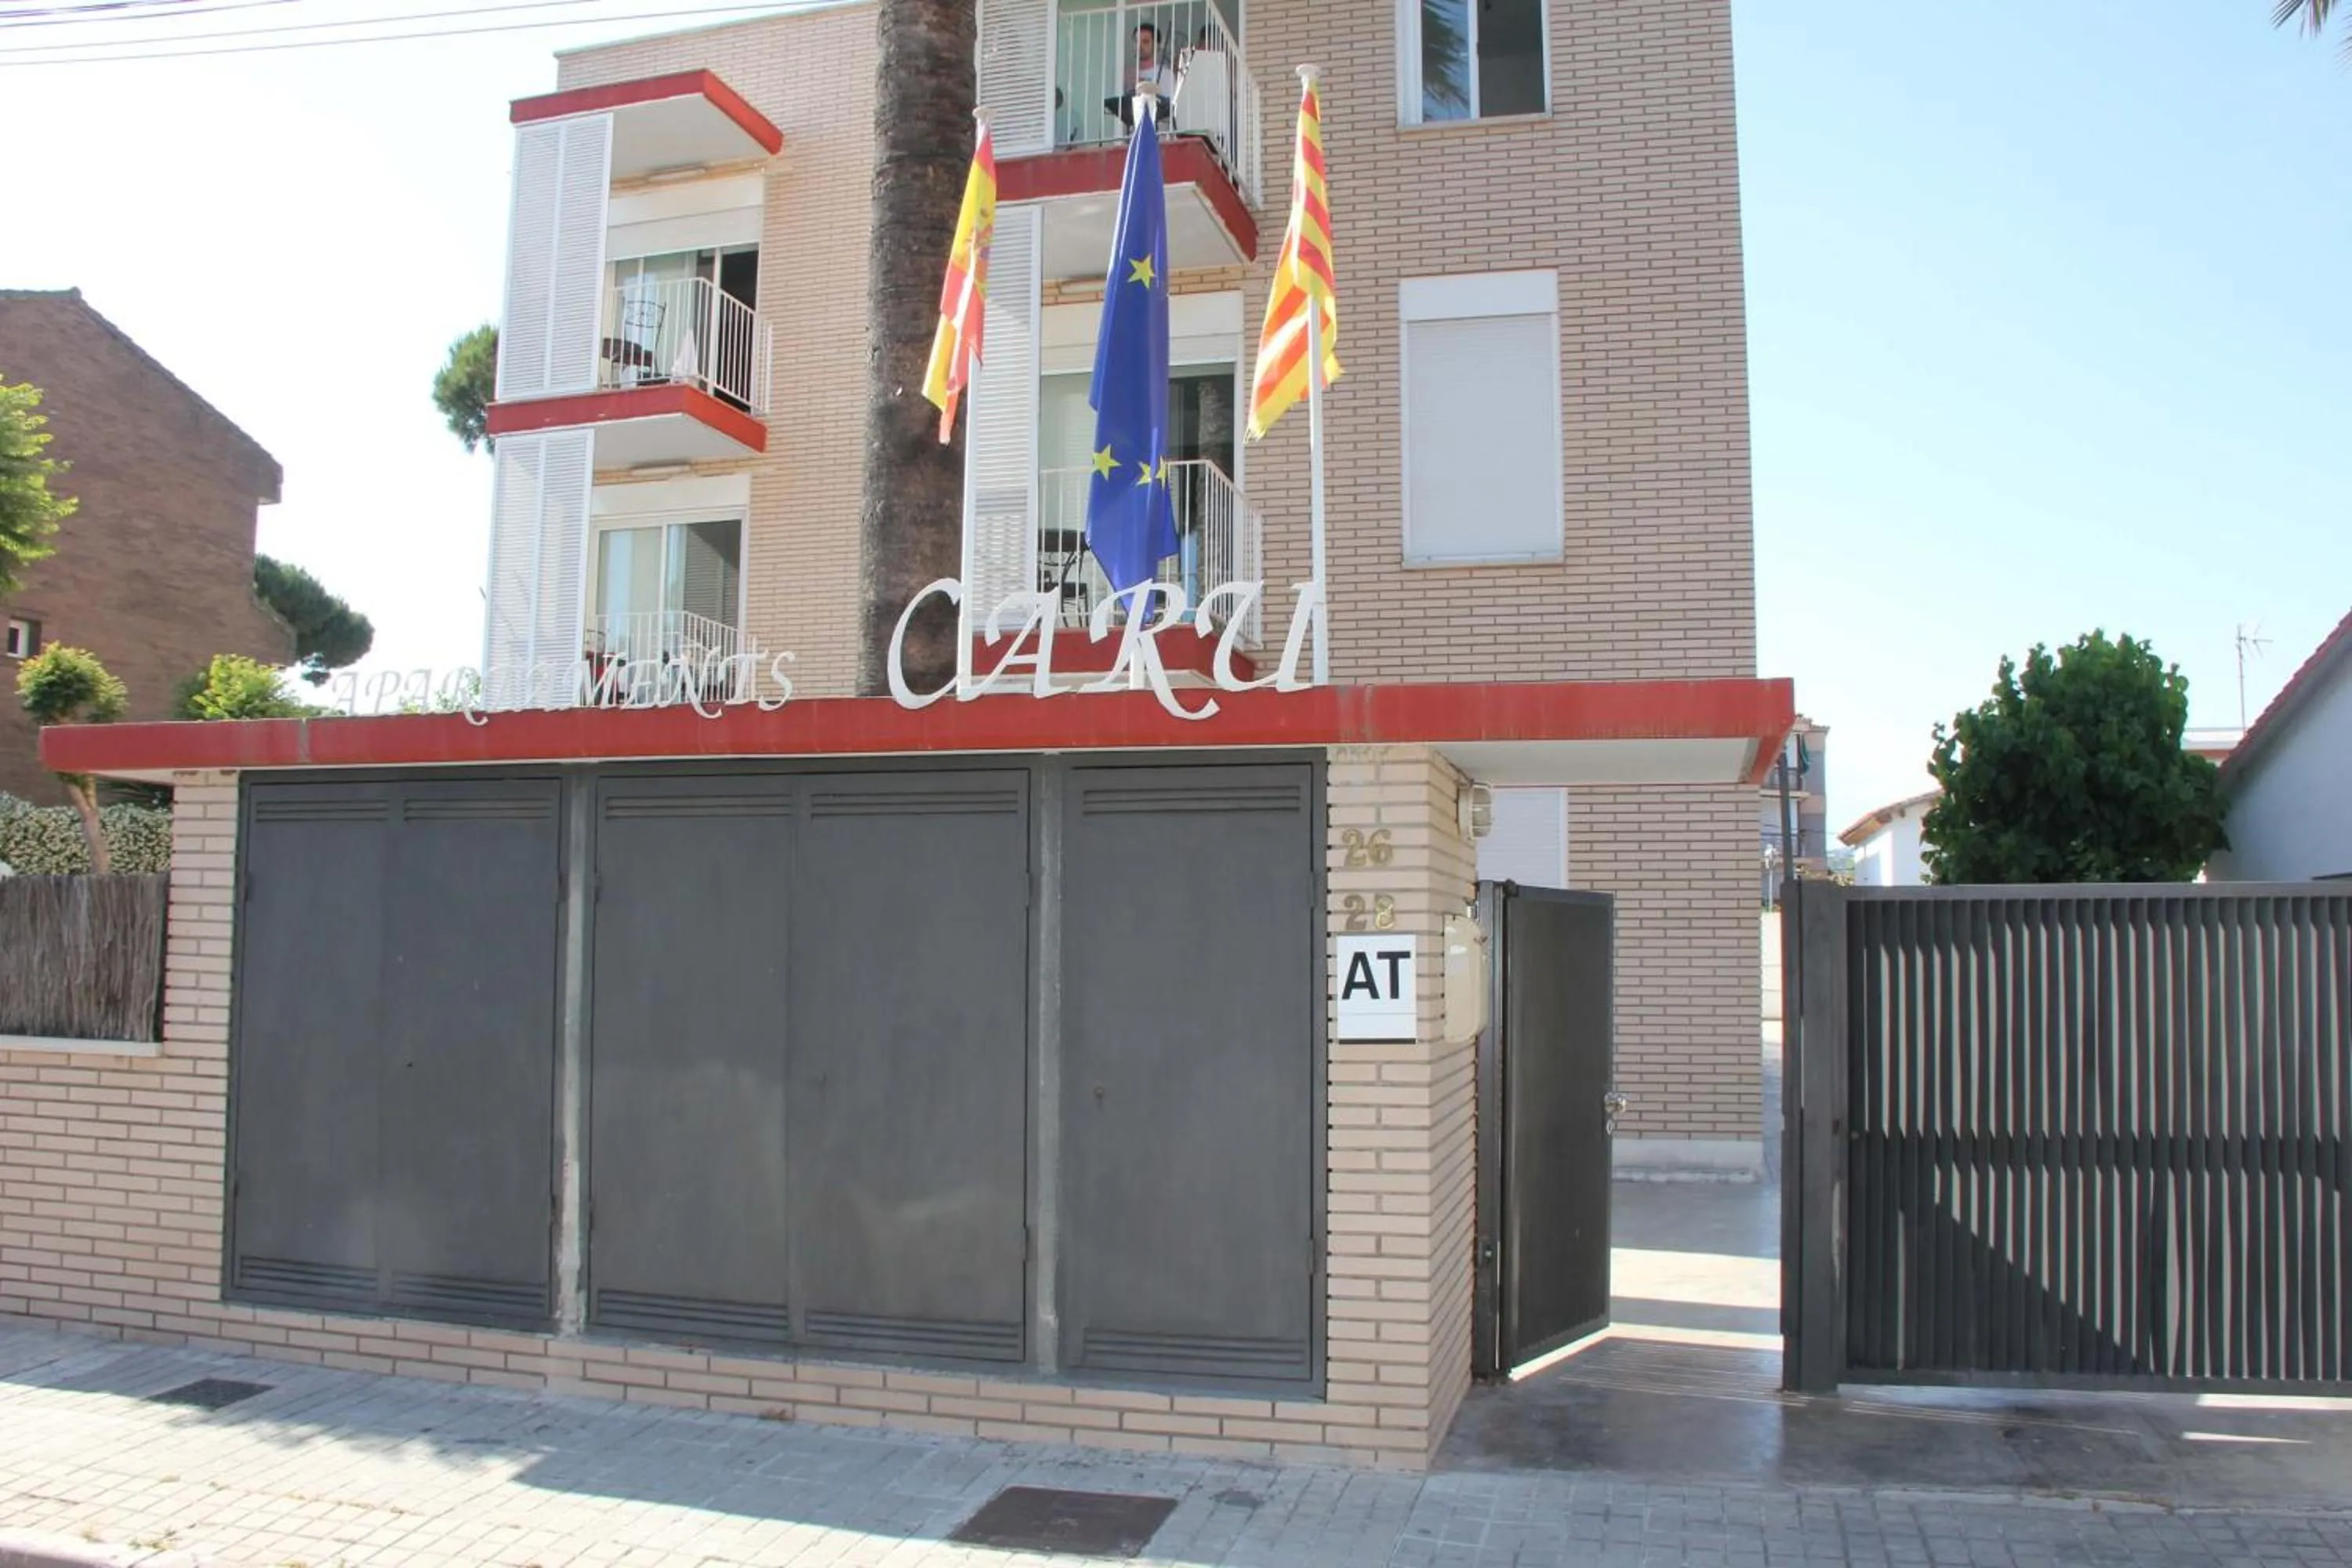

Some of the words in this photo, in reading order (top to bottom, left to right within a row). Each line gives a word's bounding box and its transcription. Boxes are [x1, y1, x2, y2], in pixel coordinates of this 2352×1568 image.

[887, 578, 1315, 720] CARU
[1341, 829, 1393, 867] 26
[1344, 893, 1396, 931] 28
[1341, 951, 1411, 1000] AT
